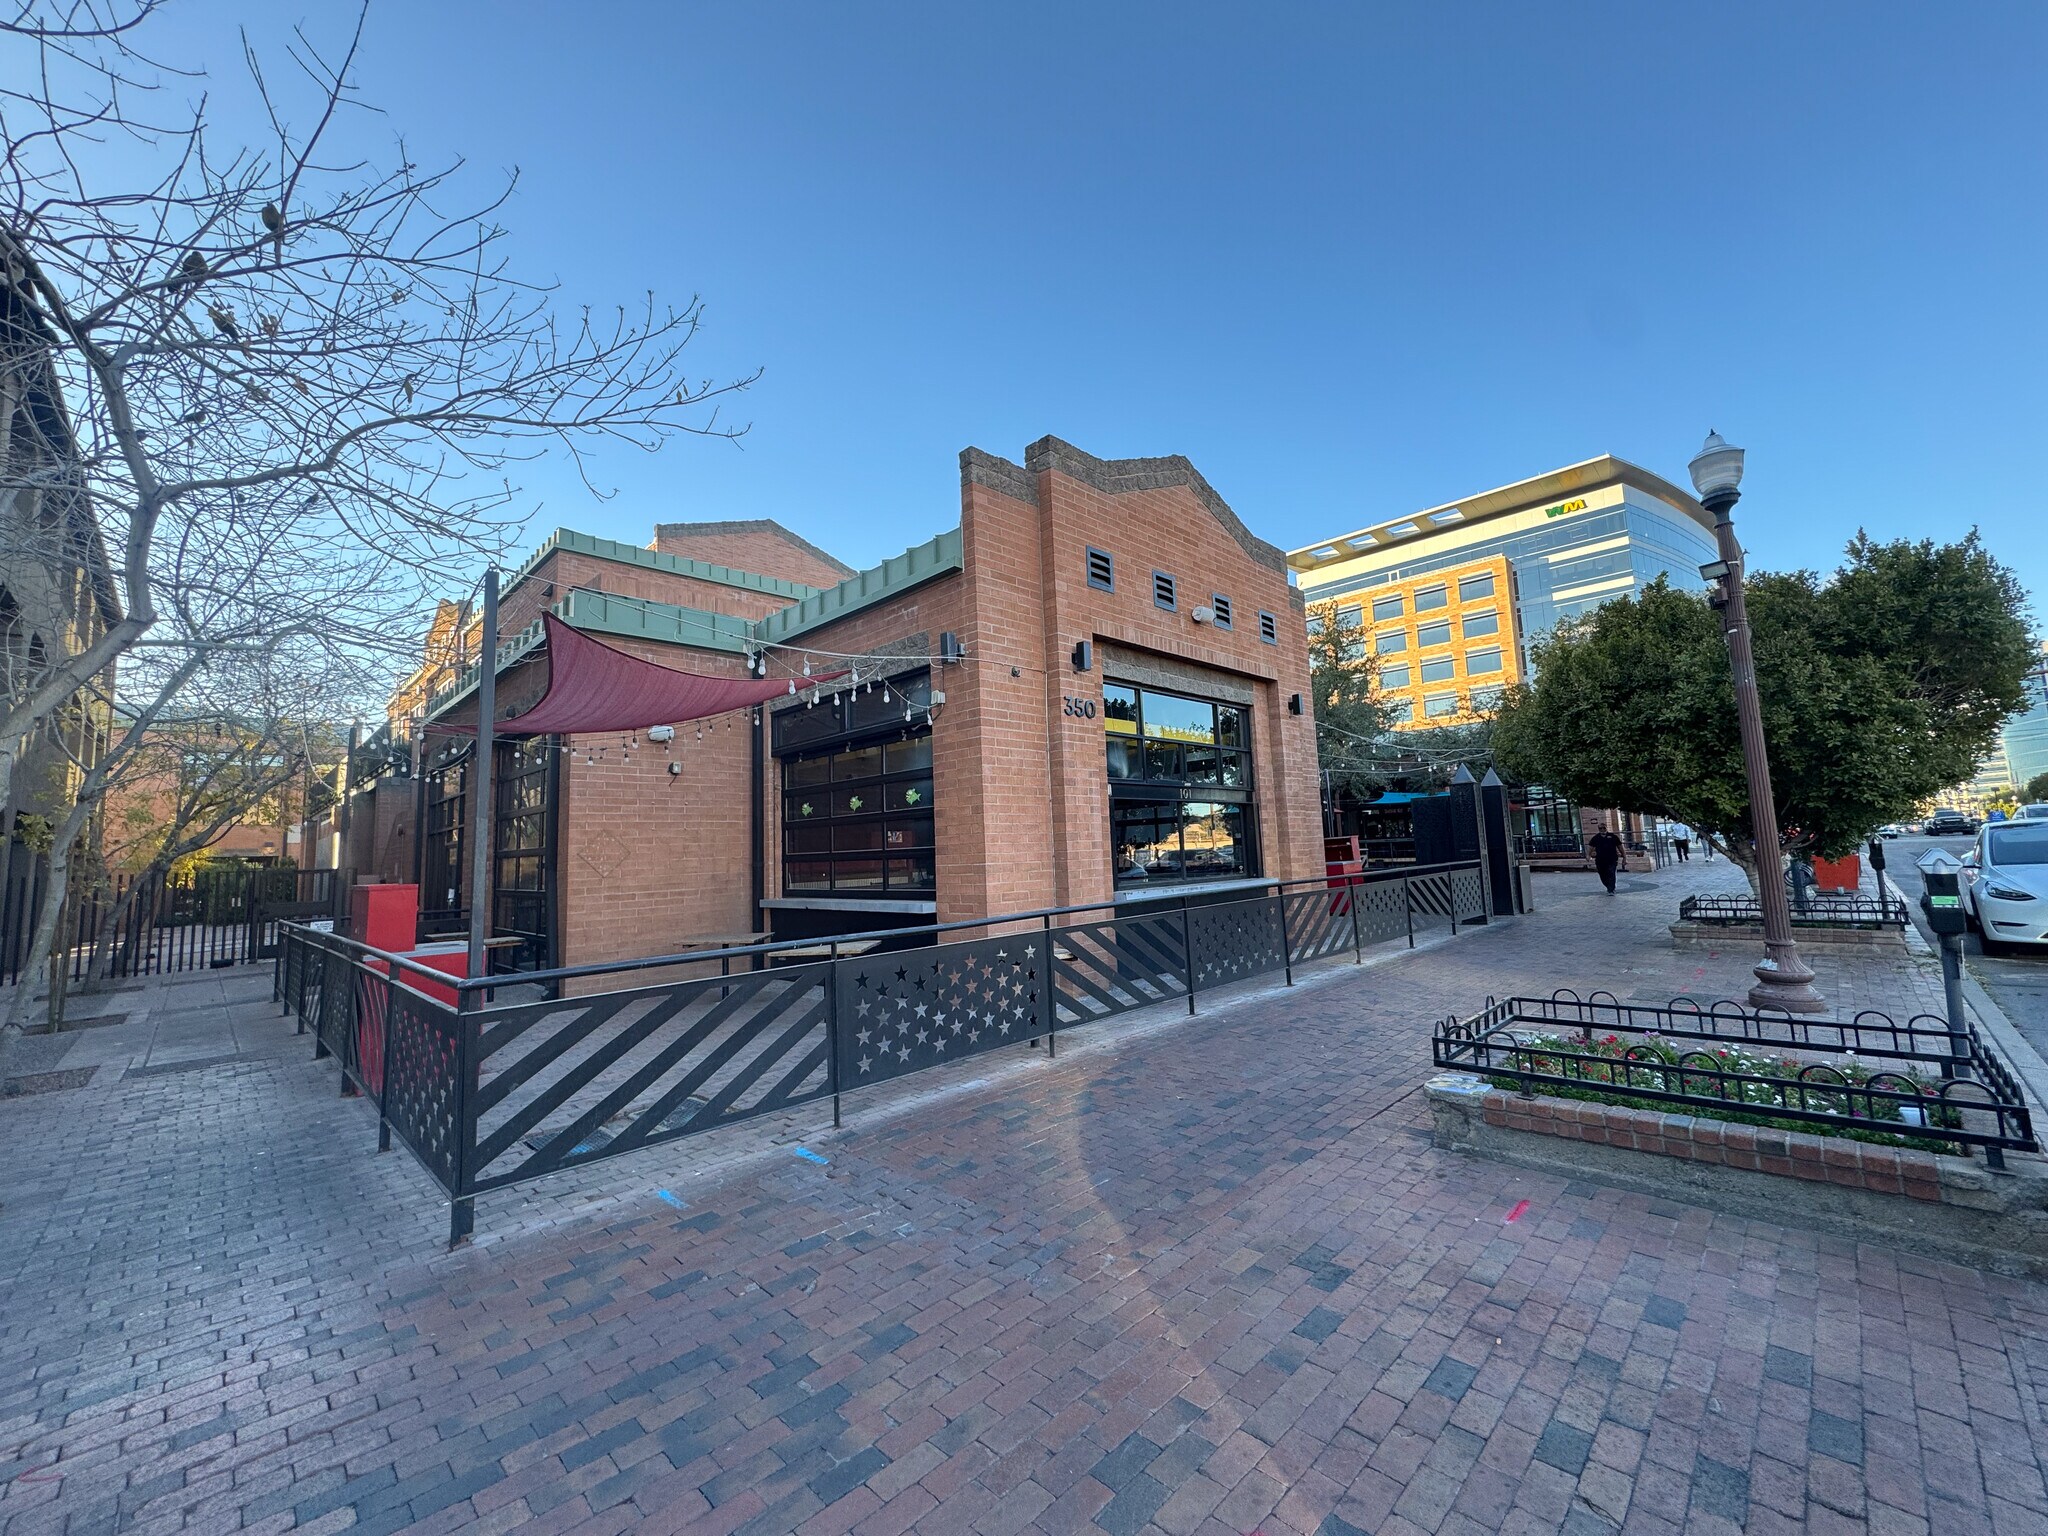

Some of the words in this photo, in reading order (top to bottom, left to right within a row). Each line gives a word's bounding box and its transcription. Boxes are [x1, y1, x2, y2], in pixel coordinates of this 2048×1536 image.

[1545, 499, 1587, 518] WM
[1063, 695, 1096, 719] 350
[1179, 788, 1192, 799] 101
